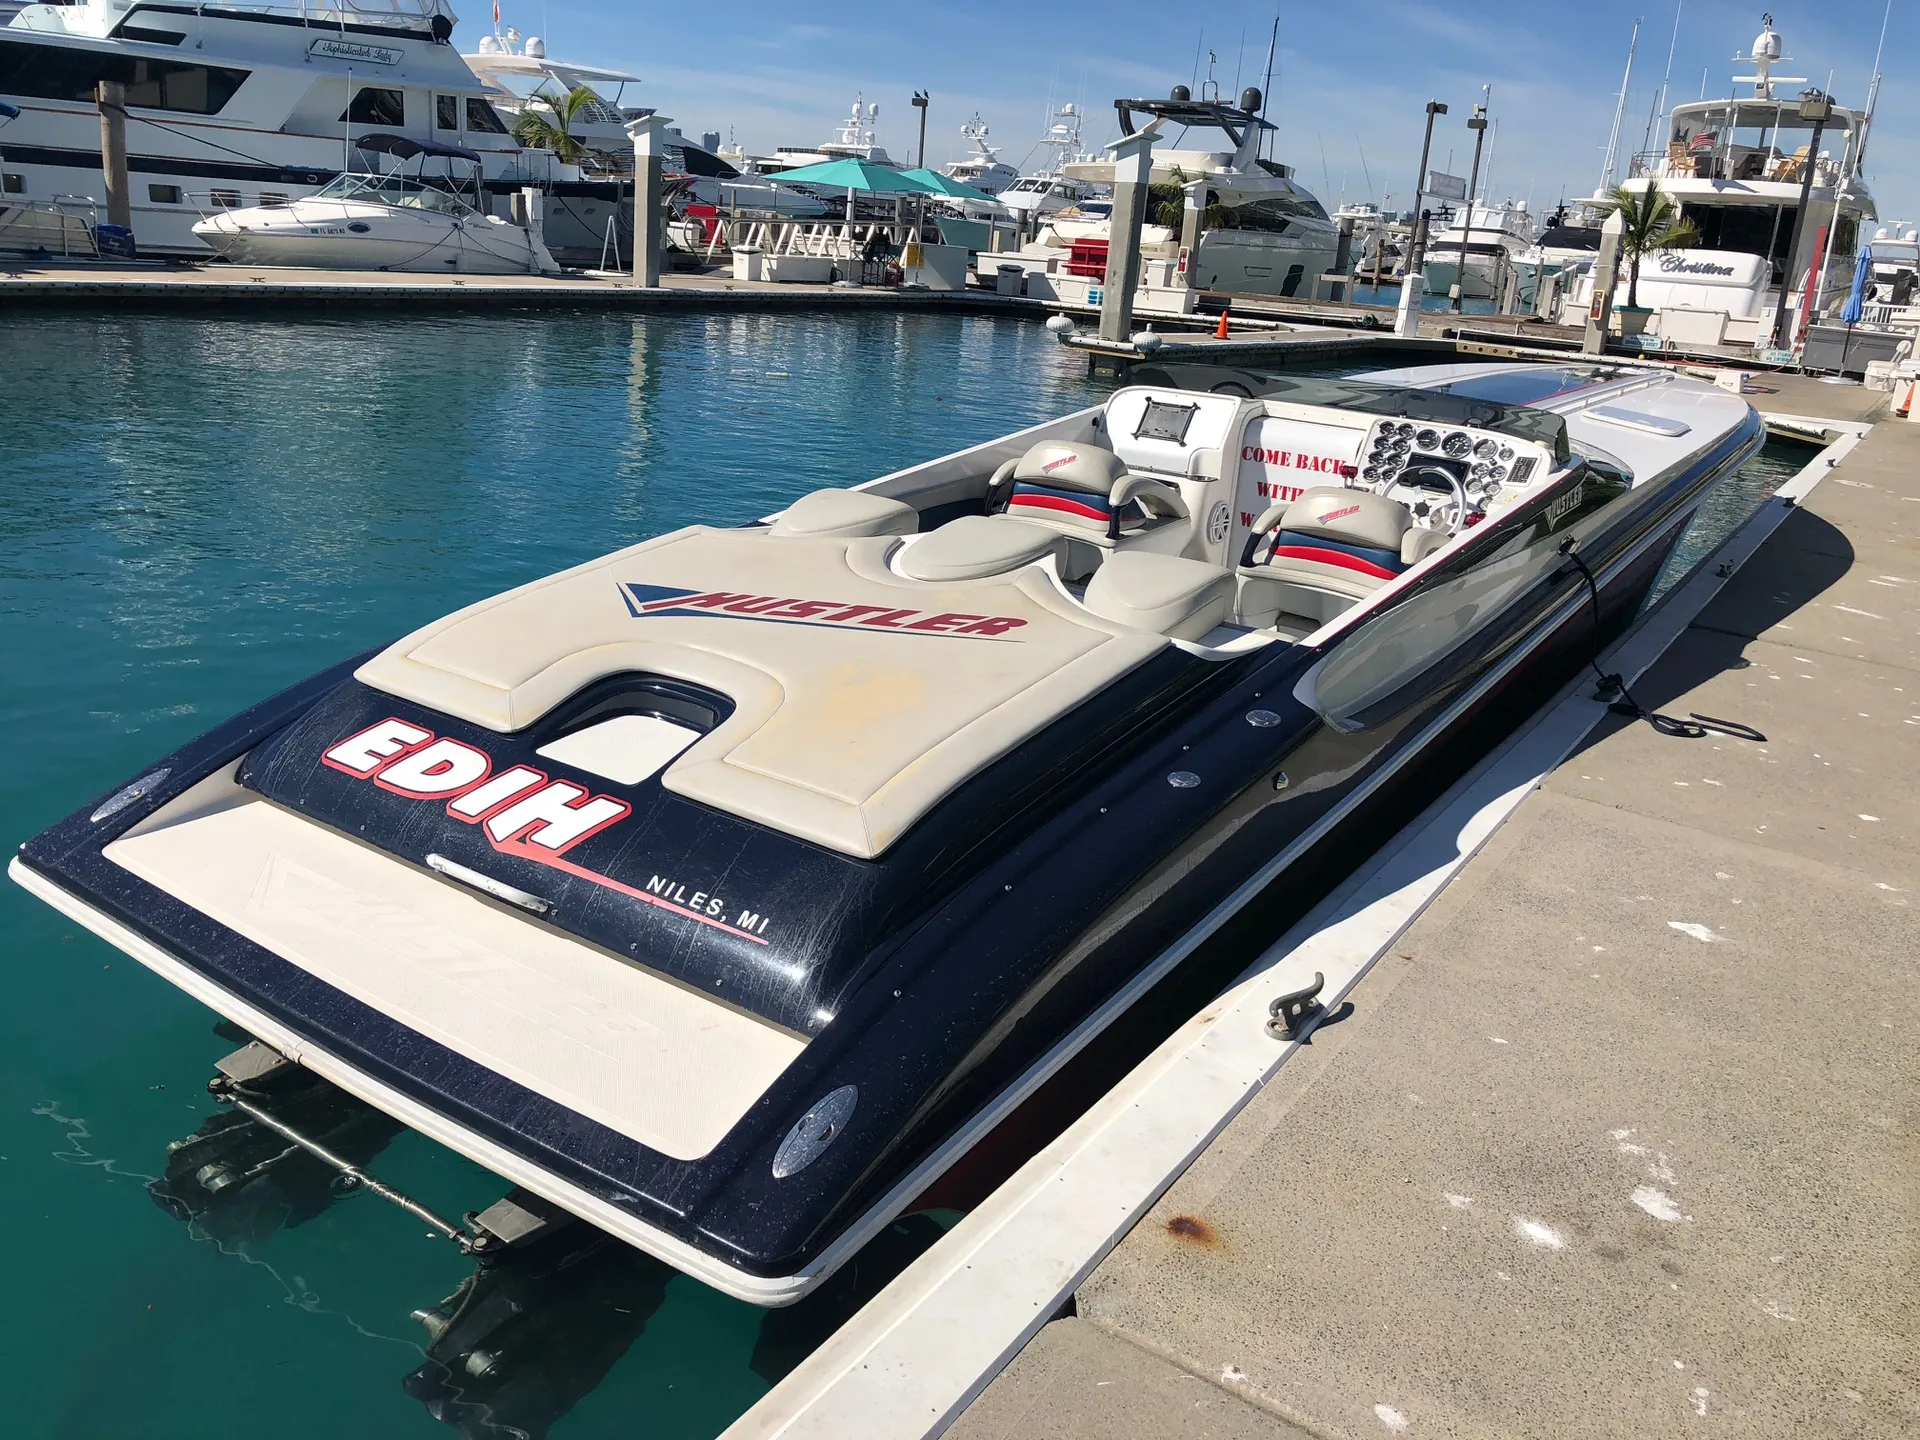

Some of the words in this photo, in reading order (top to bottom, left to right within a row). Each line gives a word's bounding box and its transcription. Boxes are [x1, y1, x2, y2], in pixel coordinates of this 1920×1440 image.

[323, 42, 371, 56] Sophisticated
[373, 49, 393, 63] Lady
[1659, 253, 1735, 276] Christina
[1241, 445, 1291, 467] COME
[1295, 454, 1346, 475] BACK
[1549, 486, 1582, 522] HUSTLER
[642, 590, 1029, 636] HUSTLER
[323, 717, 632, 853] EDIH
[646, 875, 728, 921] NILES,
[737, 911, 769, 935] MI
